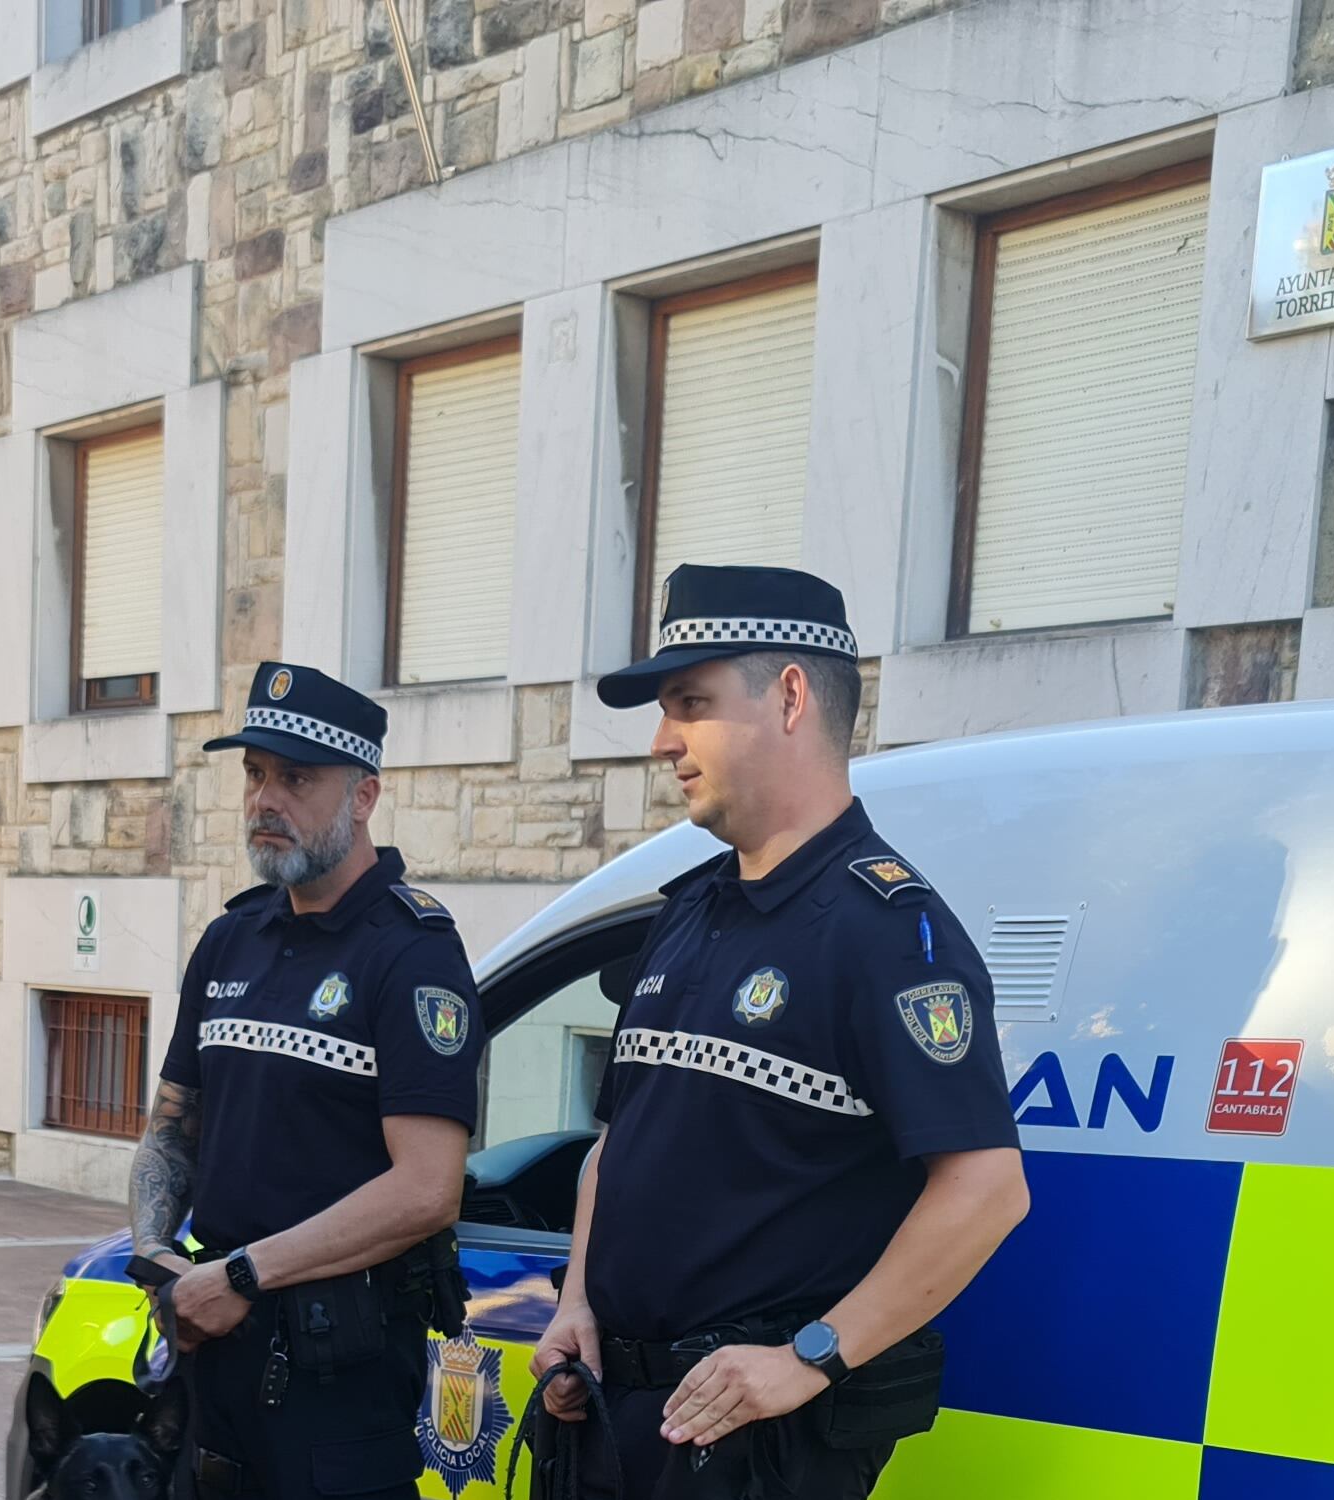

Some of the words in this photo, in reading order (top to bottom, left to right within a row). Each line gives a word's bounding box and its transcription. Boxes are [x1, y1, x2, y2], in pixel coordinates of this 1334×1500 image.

[206, 980, 250, 999] OLICIA
[903, 1008, 928, 1044] POLICIA
[1008, 1050, 1175, 1133] AN
[1217, 1057, 1295, 1098] 112
[1214, 1102, 1284, 1117] CANTABRIA
[424, 1416, 457, 1467] POLICIA
[459, 1430, 491, 1467] LOCAL
